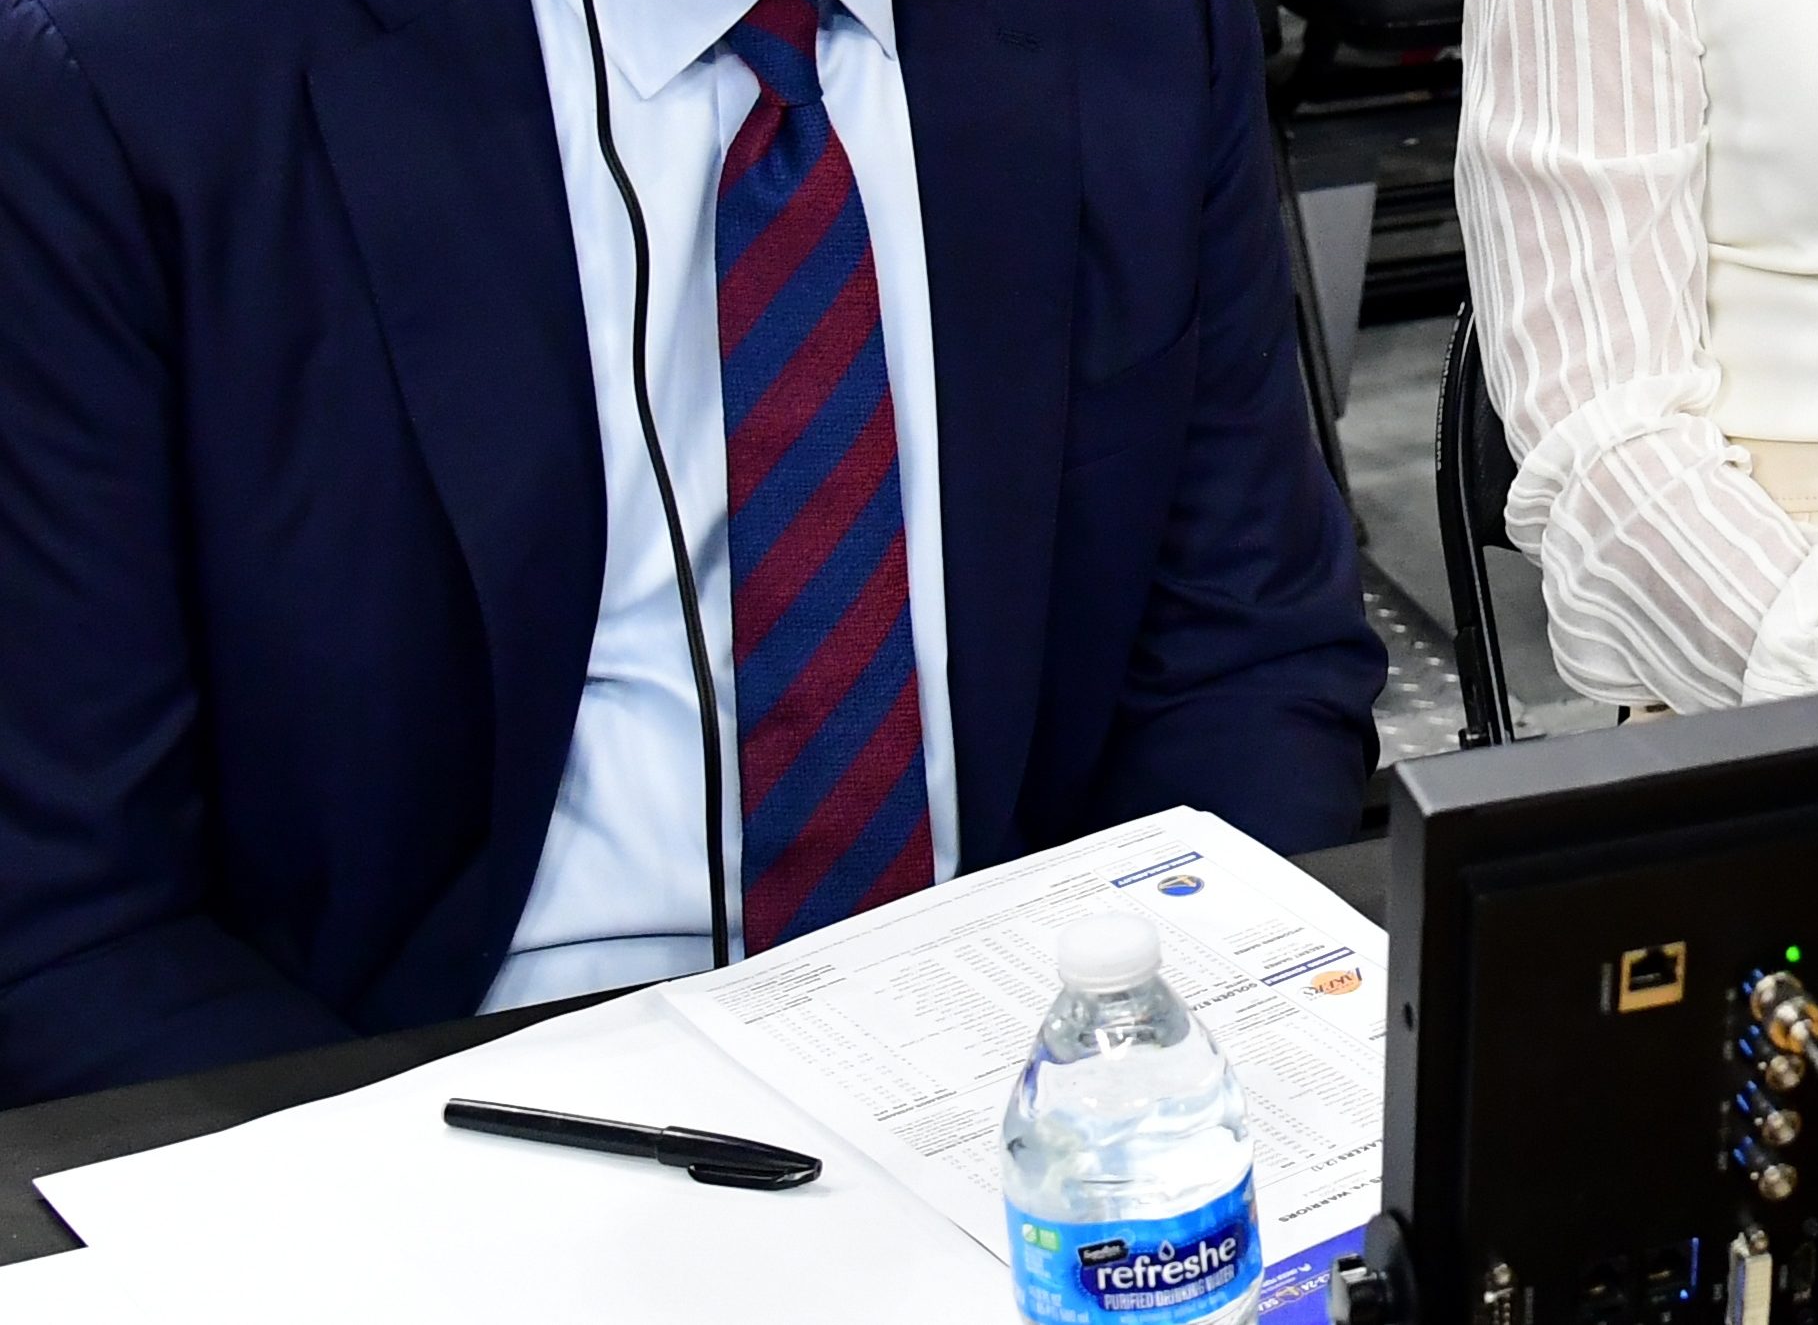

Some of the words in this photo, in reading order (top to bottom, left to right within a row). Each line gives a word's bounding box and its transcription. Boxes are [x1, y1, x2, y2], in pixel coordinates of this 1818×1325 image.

[1277, 1190, 1352, 1223] WARRIORS
[1096, 1236, 1237, 1291] refreshe
[1103, 1291, 1154, 1312] PURIFIED
